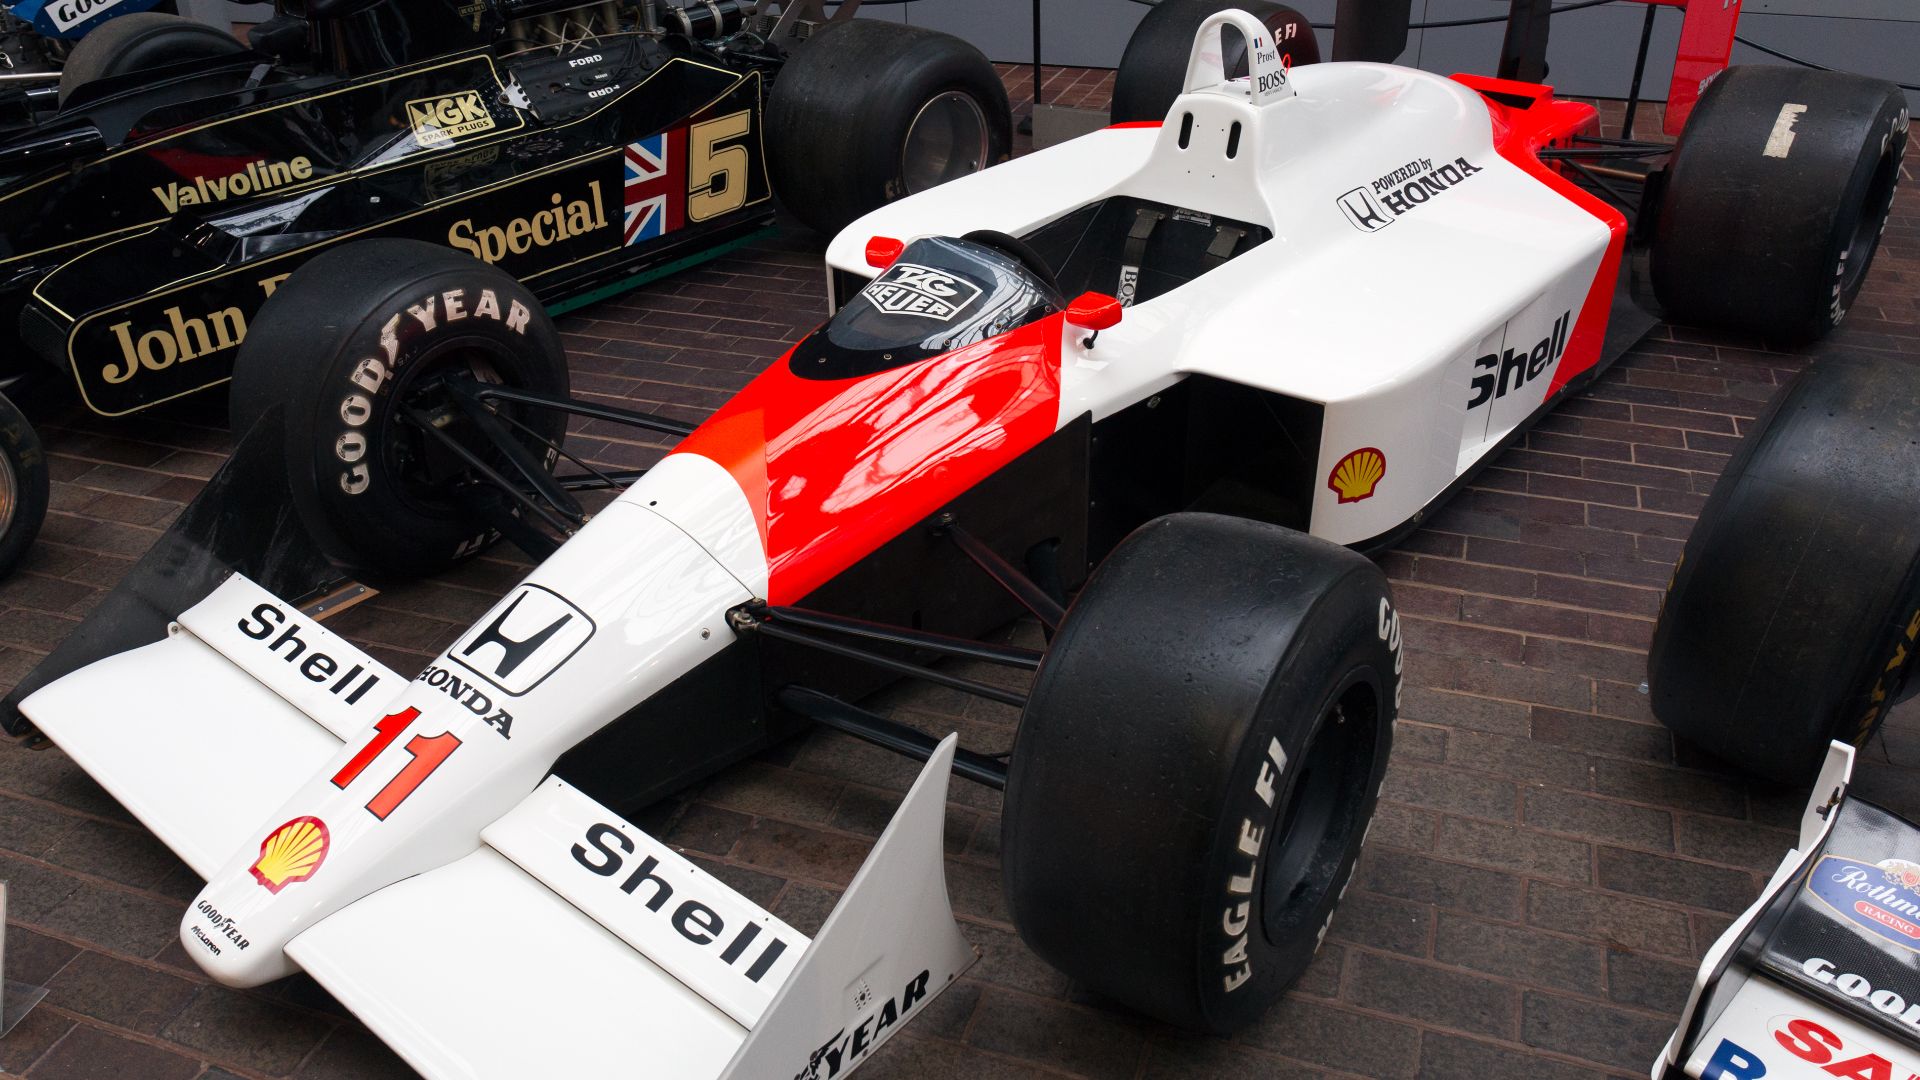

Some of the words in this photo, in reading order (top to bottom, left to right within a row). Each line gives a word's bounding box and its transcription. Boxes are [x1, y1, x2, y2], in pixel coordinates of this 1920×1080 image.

[568, 54, 603, 68] FORD
[1256, 49, 1276, 65] Prost
[1257, 68, 1287, 94] BOSS
[410, 92, 487, 132] NGK
[422, 129, 454, 144] SPARK
[457, 120, 490, 134] PLUGS
[152, 155, 313, 214] Valvoline
[688, 108, 750, 223] 5
[1371, 160, 1421, 195] POWERED
[1418, 158, 1433, 171] by
[1380, 156, 1484, 216] HONDA
[448, 180, 609, 265] Special
[867, 285, 950, 316] HEUER
[892, 266, 958, 297] TAG
[102, 306, 248, 384] John
[1466, 309, 1571, 411] Shell
[236, 602, 381, 706] Shell
[416, 665, 514, 741] HONDA
[330, 705, 464, 822] 11
[570, 821, 788, 984] Shell
[1223, 817, 1266, 993] EAGLE
[1831, 865, 1920, 921] Rothm
[1862, 905, 1915, 934] RACING
[190, 924, 222, 957] McLaren
